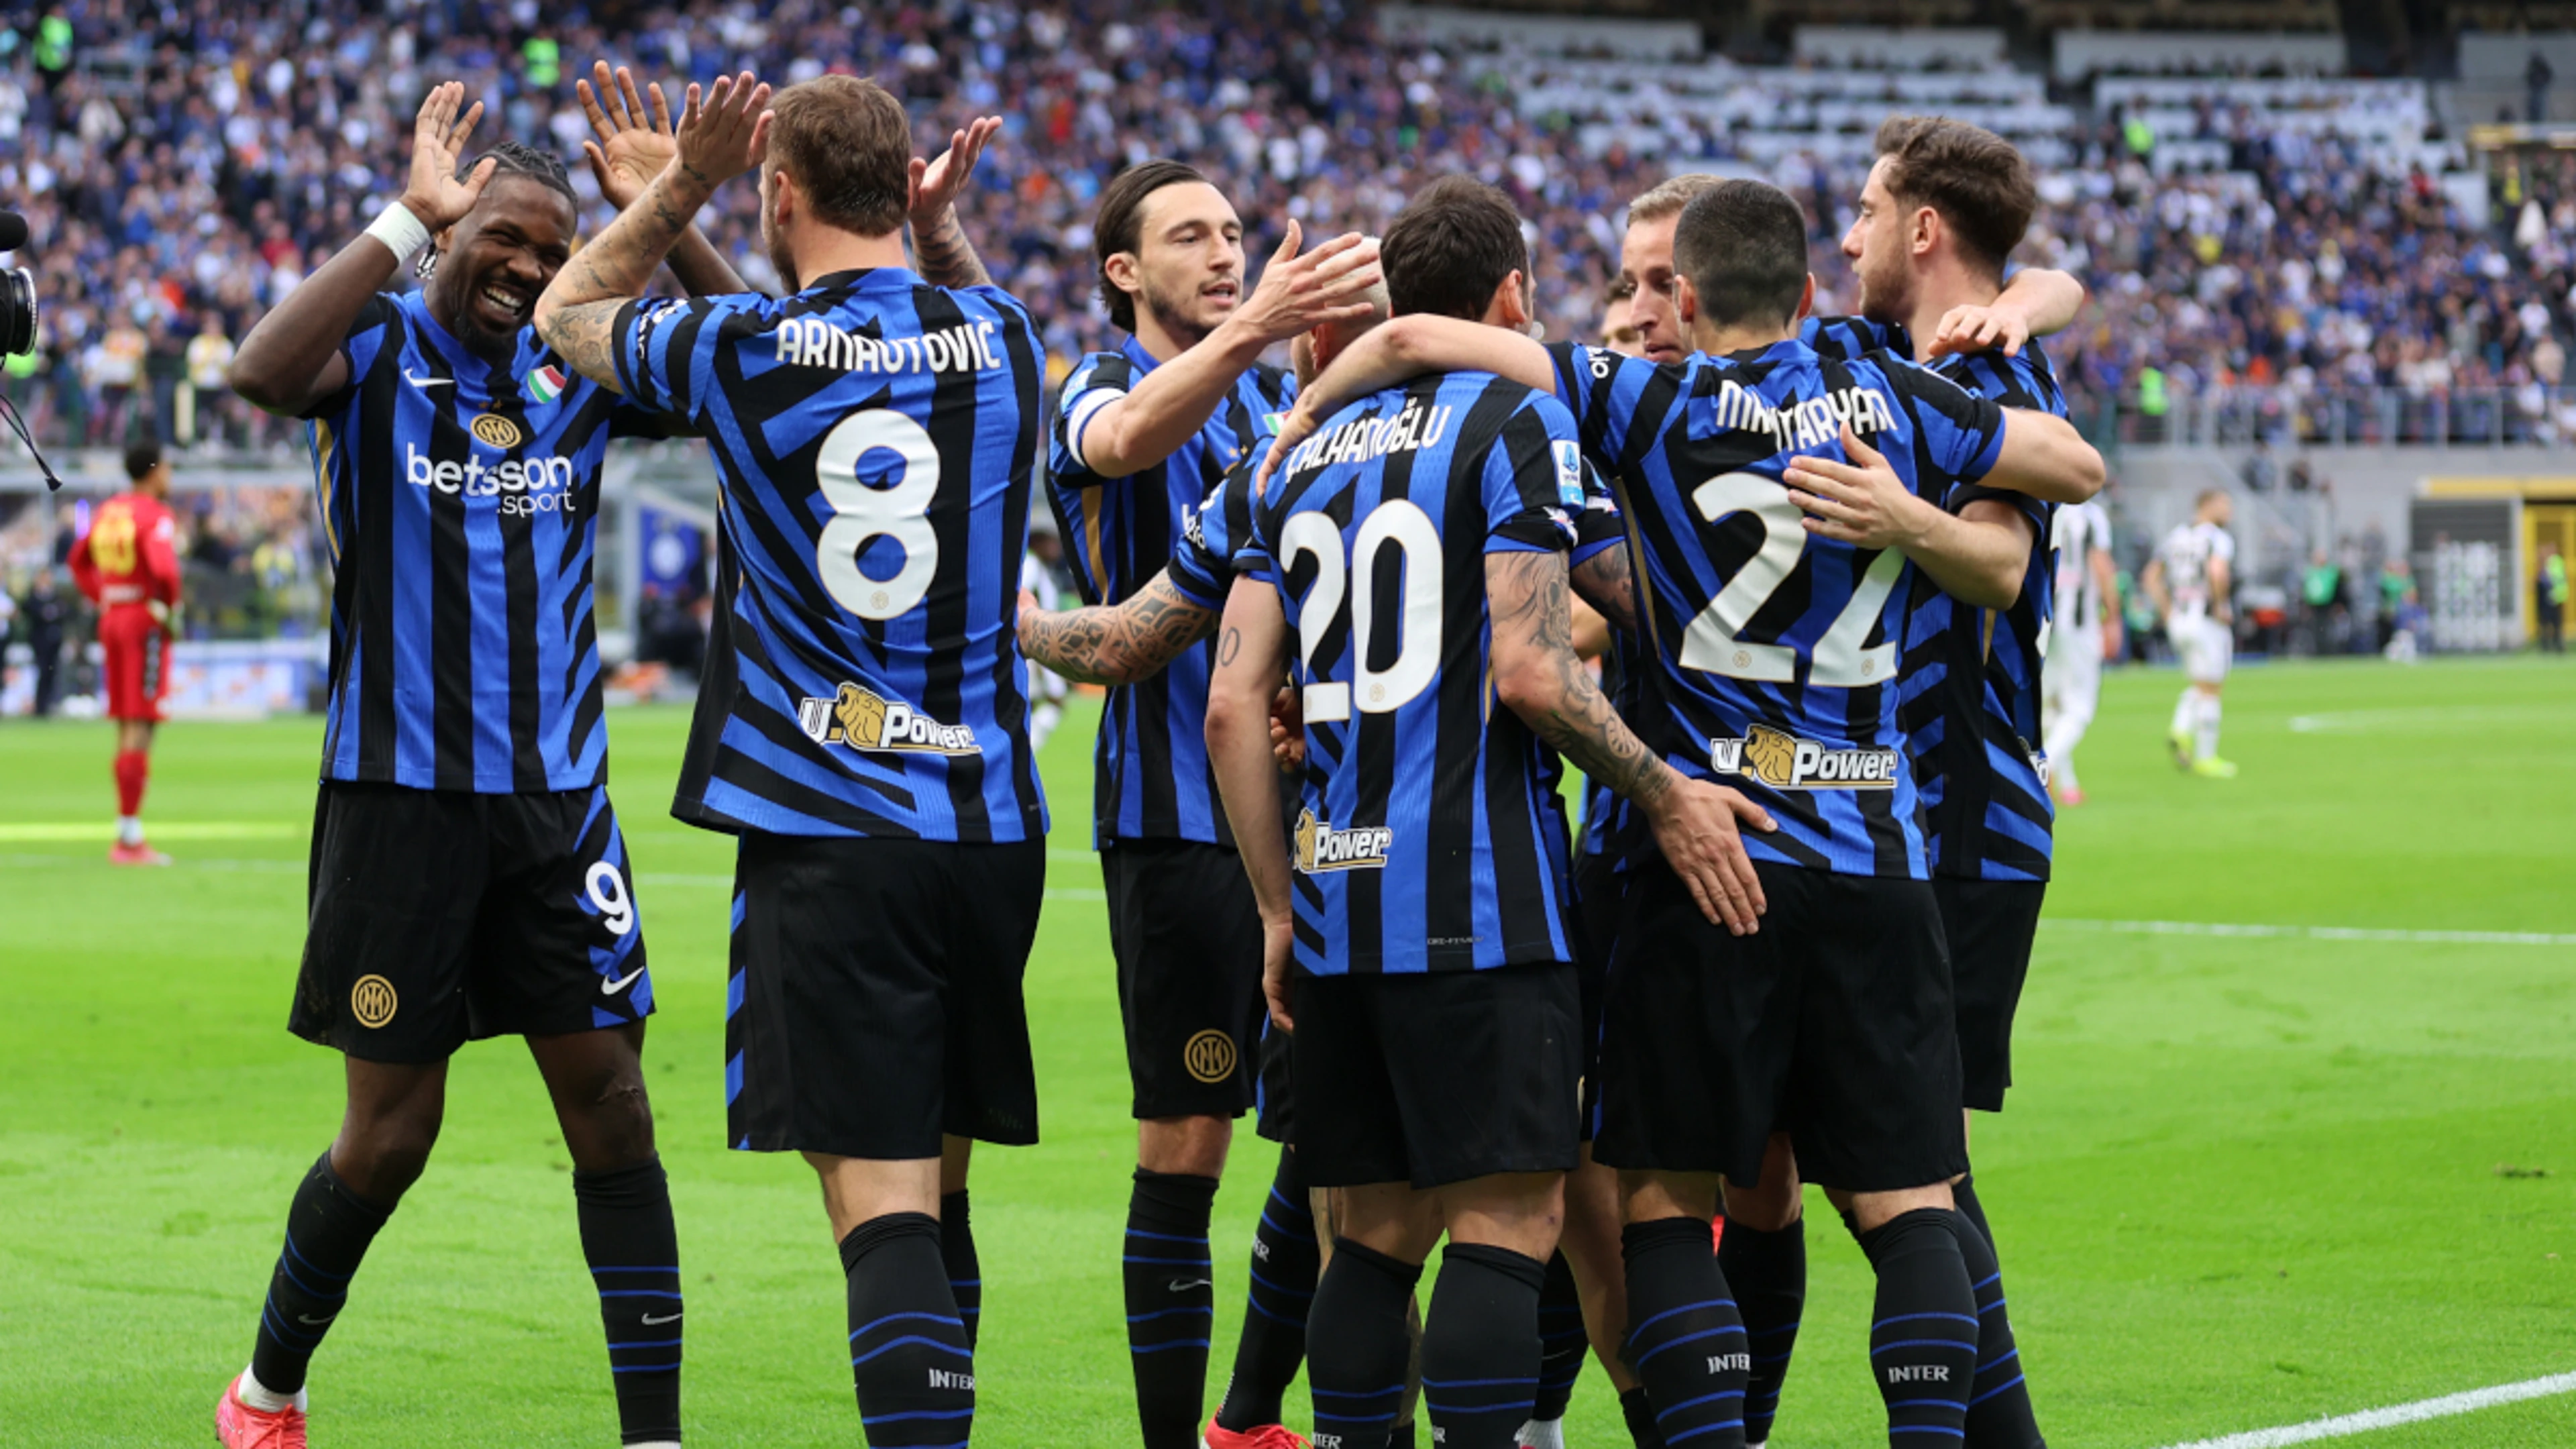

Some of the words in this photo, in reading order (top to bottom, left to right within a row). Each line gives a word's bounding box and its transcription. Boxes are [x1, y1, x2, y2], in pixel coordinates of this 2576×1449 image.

[407, 442, 572, 496] betsson
[816, 408, 941, 621] 8
[1279, 498, 1444, 724] 20
[879, 704, 974, 749] Power
[1789, 741, 1894, 786] Power
[1313, 824, 1390, 869] Power
[585, 861, 635, 935] 9
[928, 1367, 975, 1391] INTER
[1888, 1364, 1949, 1383] INTER
